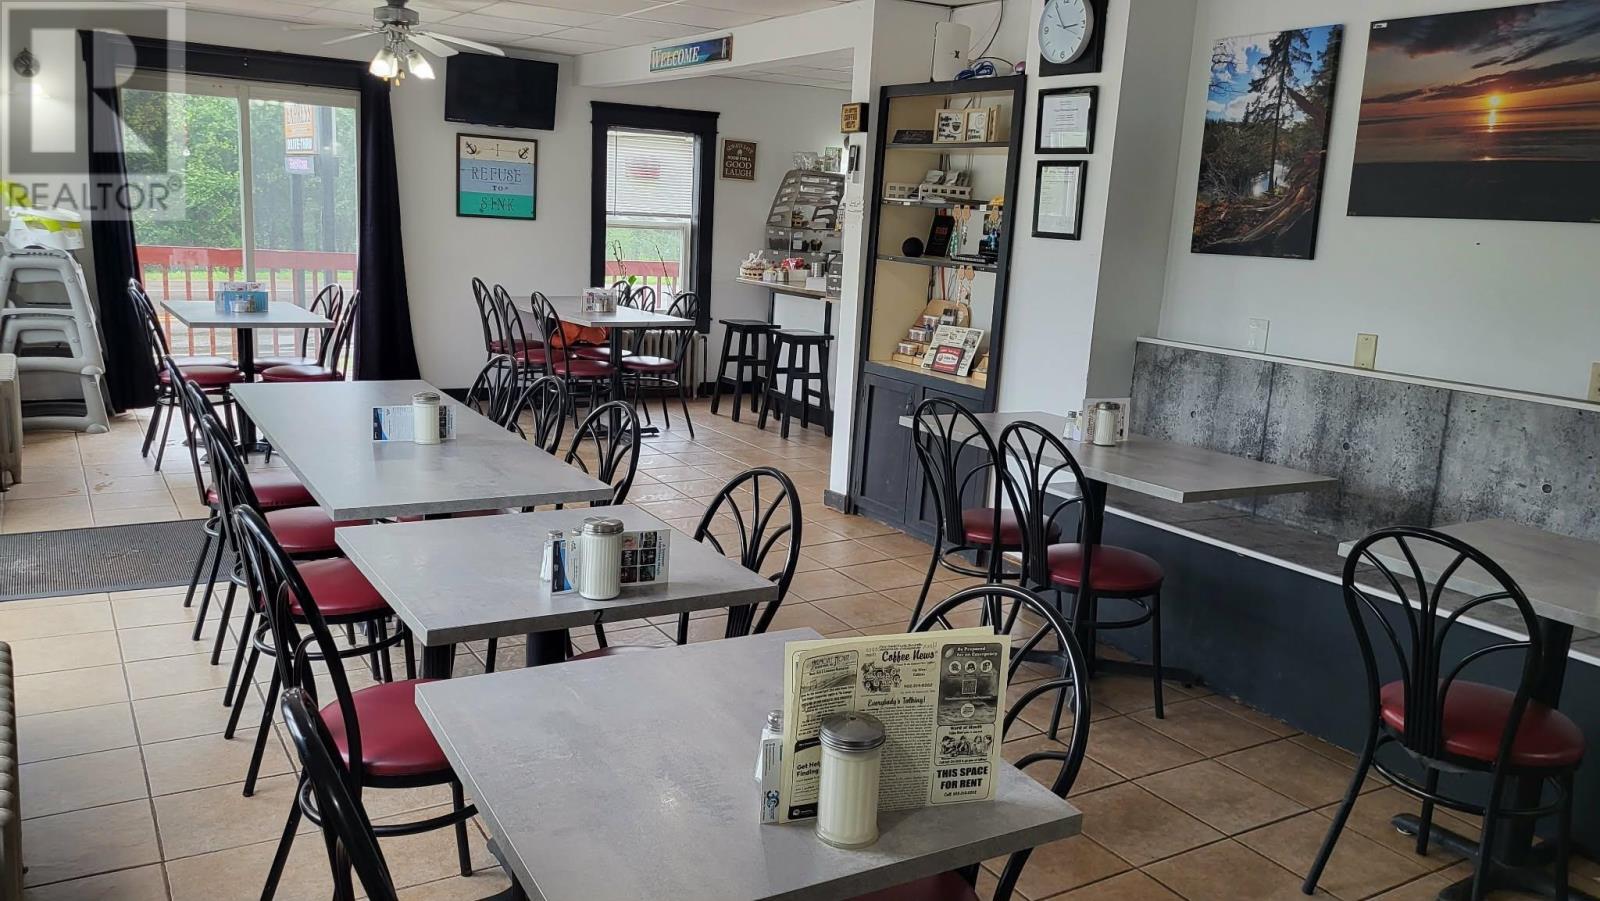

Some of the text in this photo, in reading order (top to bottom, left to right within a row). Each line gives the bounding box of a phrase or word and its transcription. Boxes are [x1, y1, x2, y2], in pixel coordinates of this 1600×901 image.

[1043, 26, 1050, 35] 9
[651, 45, 700, 69] WELCOME
[725, 160, 752, 170] GOOD
[471, 166, 522, 183] REFUSE
[725, 167, 752, 177] LAUGH
[882, 649, 935, 663] Coffee News
[868, 695, 926, 707] Everybody's Talking!
[796, 769, 819, 777] Finding
[936, 766, 988, 778] THIS SPACE
[940, 778, 983, 790] FOR RENT
